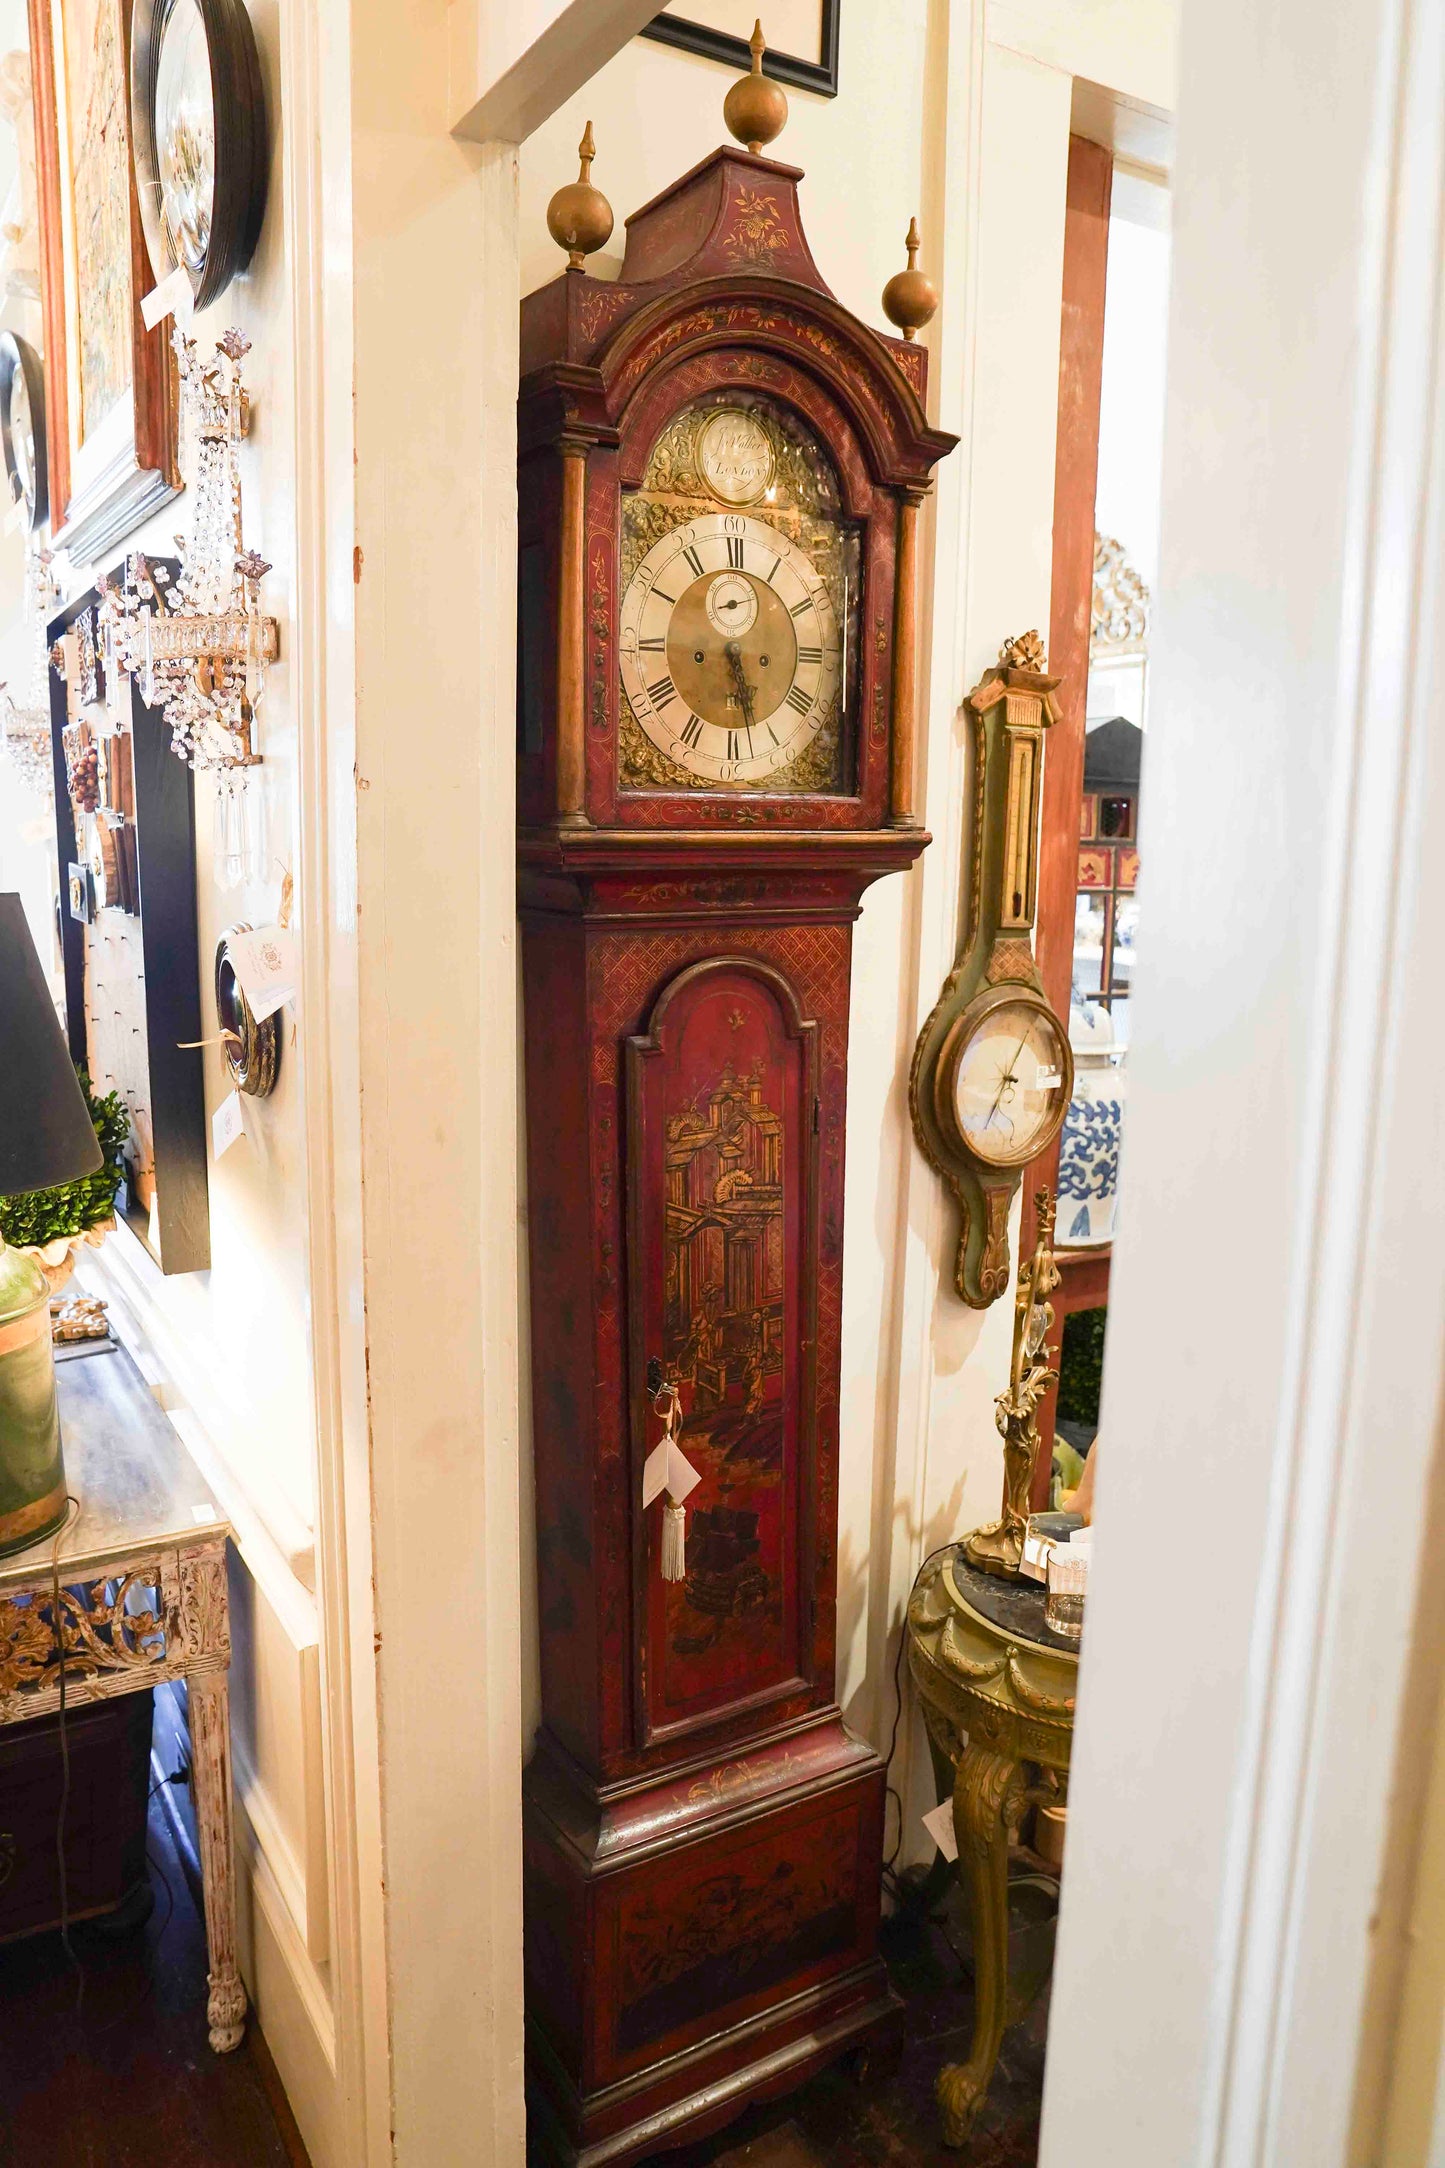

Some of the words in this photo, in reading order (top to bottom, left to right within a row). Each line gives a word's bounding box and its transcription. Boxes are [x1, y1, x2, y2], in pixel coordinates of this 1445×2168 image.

[671, 522, 696, 551] 55
[724, 515, 746, 535] 60
[630, 564, 654, 598] 50
[812, 585, 831, 611] 10
[619, 626, 637, 664] 45
[798, 646, 823, 665] III
[630, 693, 655, 725] 40
[720, 762, 746, 781] 30
